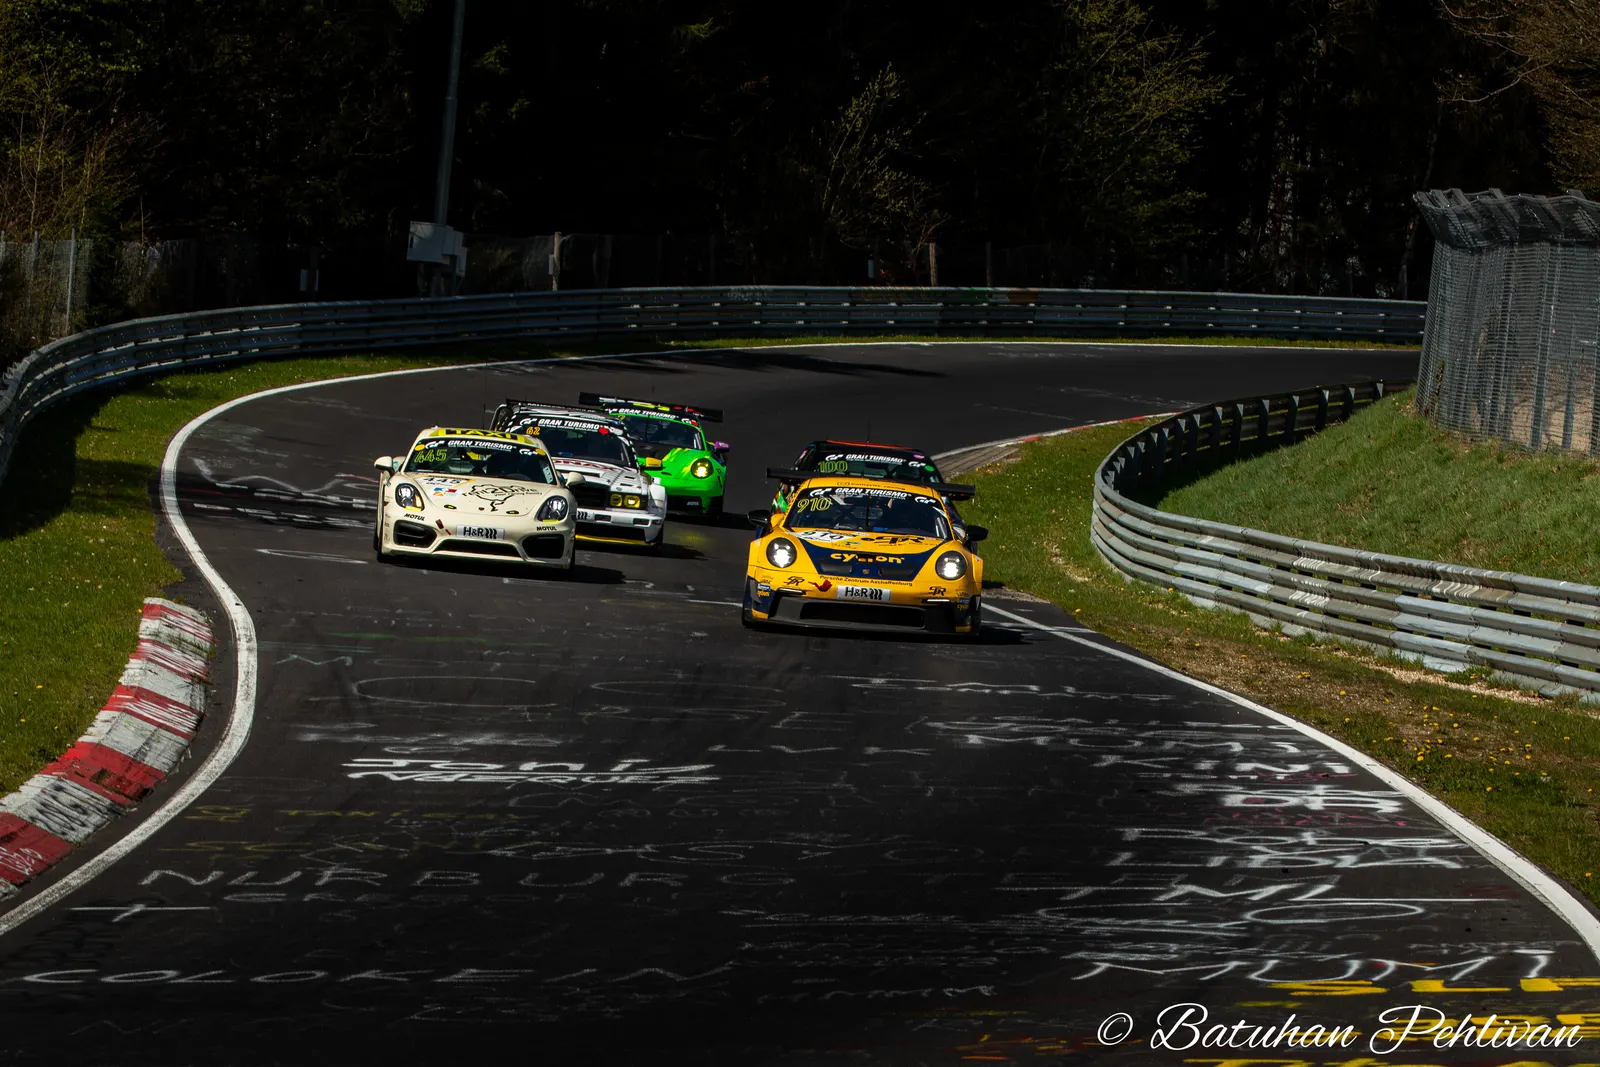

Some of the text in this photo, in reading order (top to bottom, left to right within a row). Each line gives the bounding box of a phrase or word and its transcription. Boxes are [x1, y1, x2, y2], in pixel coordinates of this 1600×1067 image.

[618, 407, 642, 415] GRAN
[538, 418, 561, 426] GRAN
[564, 420, 600, 430] TURISMO
[526, 426, 541, 436] 62
[474, 441, 513, 450] TURISMO
[414, 448, 448, 463] 445
[868, 454, 903, 463] TURISMO
[818, 461, 848, 473] 100
[865, 488, 908, 498] TURISMO
[797, 497, 832, 513] 910
[404, 512, 425, 521] MOTUL
